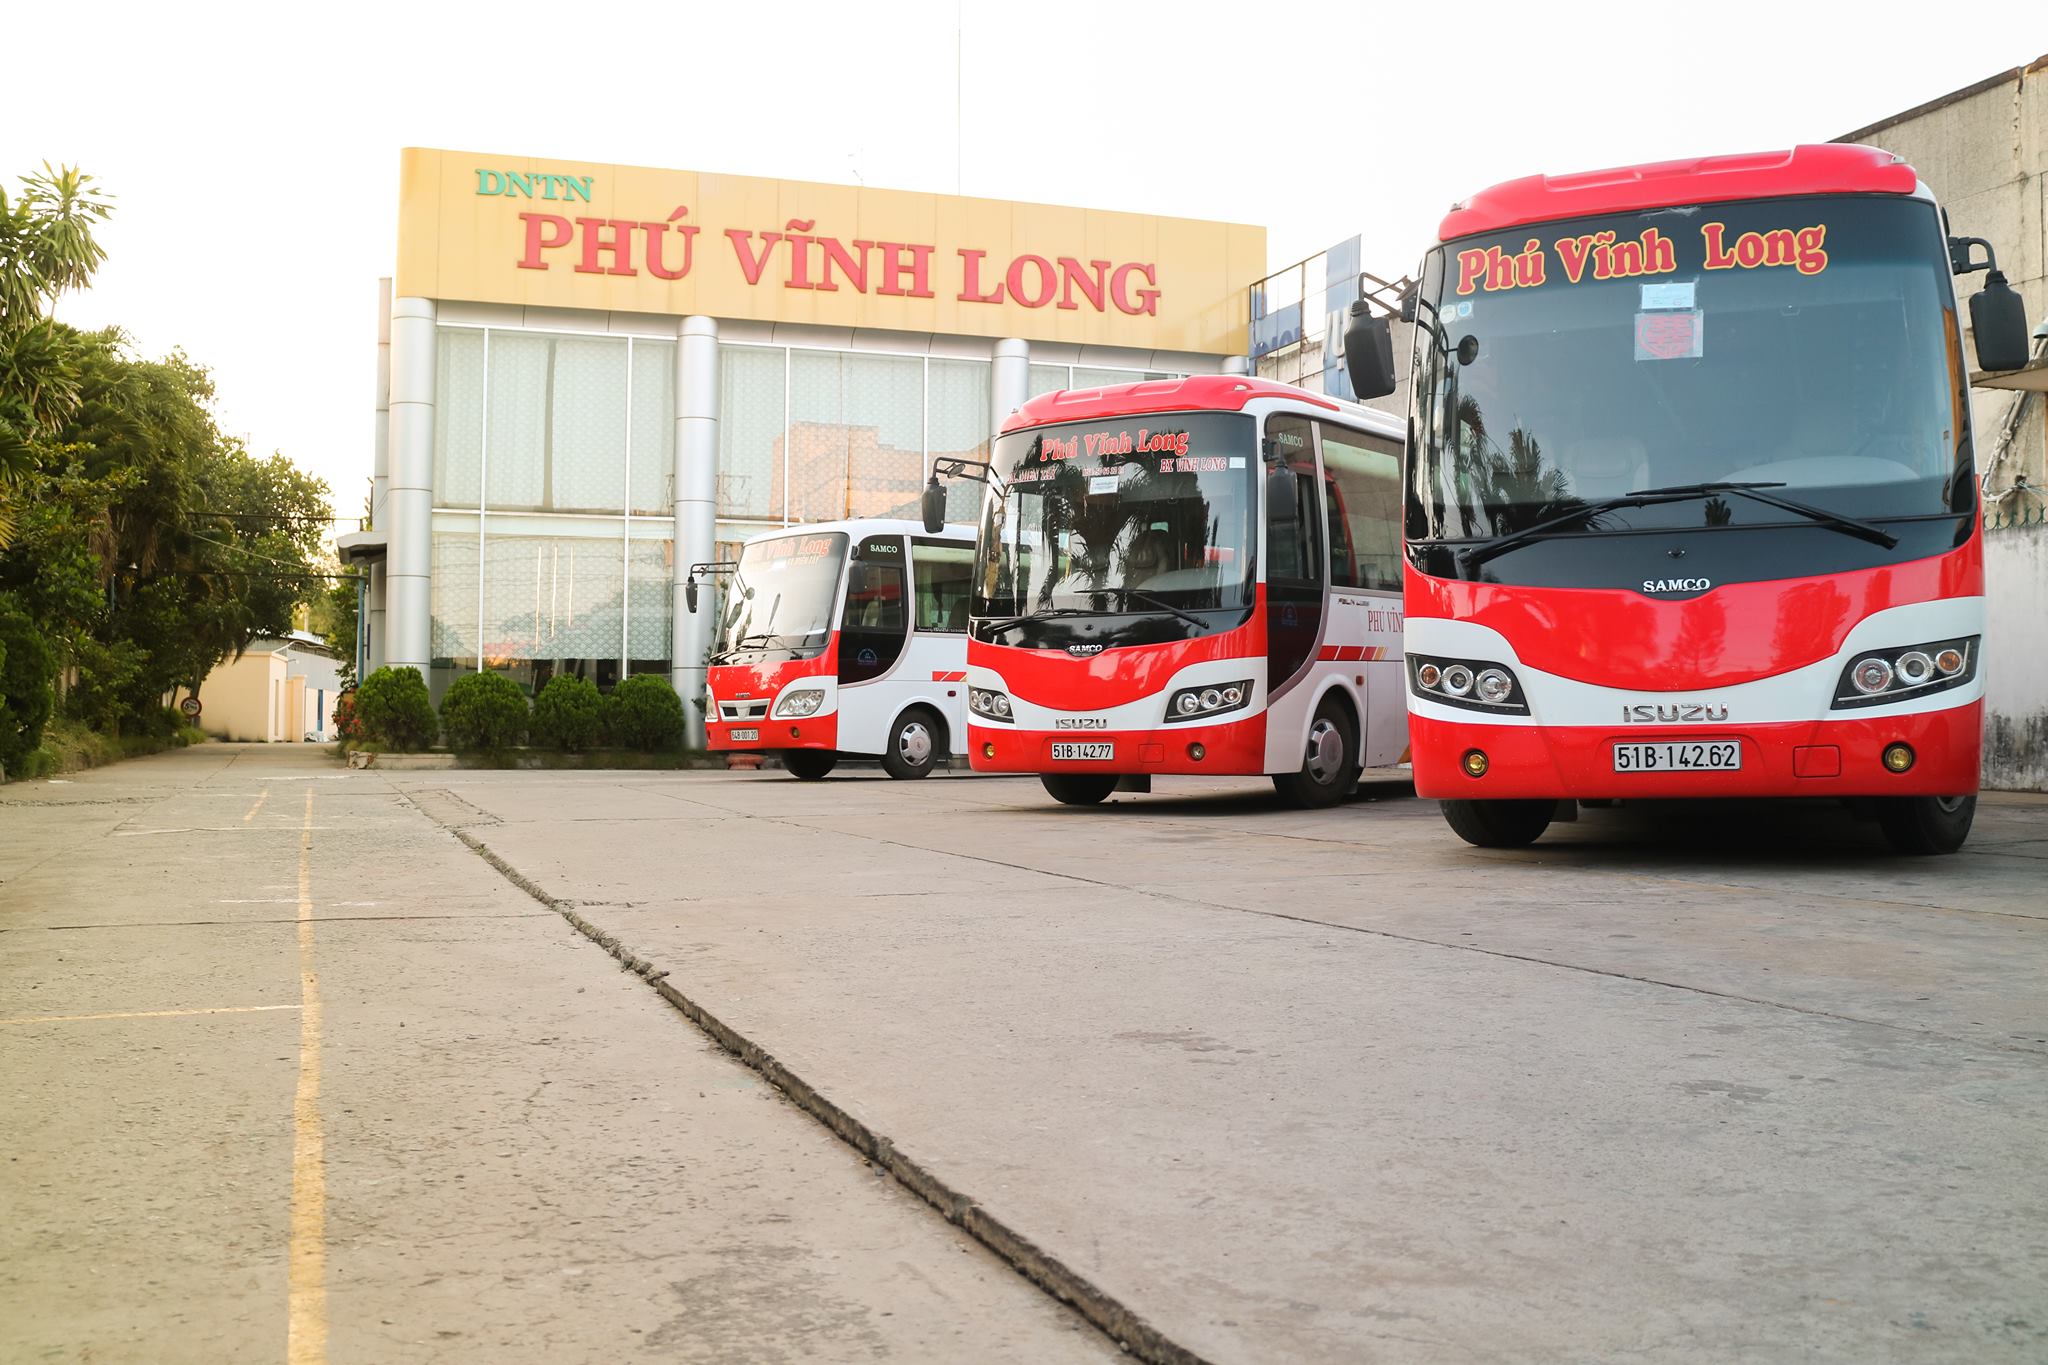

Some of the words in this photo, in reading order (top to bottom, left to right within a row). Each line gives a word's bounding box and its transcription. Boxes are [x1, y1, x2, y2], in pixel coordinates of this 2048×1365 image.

[475, 168, 594, 202] DNTN
[517, 205, 701, 281] PHÚ
[723, 218, 935, 299] VĨNH
[957, 248, 1161, 317] LONG
[1456, 238, 1546, 295] Phú
[1554, 227, 1677, 283] Vĩnh
[1700, 221, 1828, 275] Long
[1040, 434, 1079, 462] Phú
[1136, 428, 1190, 456] Long
[1278, 432, 1304, 448] SAMCO
[1200, 456, 1227, 472] LONG
[870, 544, 898, 554] SAMCO
[1643, 578, 1711, 593] SAMCO
[1367, 605, 1385, 633] PHÚ
[1069, 644, 1103, 653] SAMCO
[1623, 702, 1729, 723] ISUZU
[1055, 718, 1108, 729] ISUZU
[1618, 744, 1736, 769] 51B-142.62
